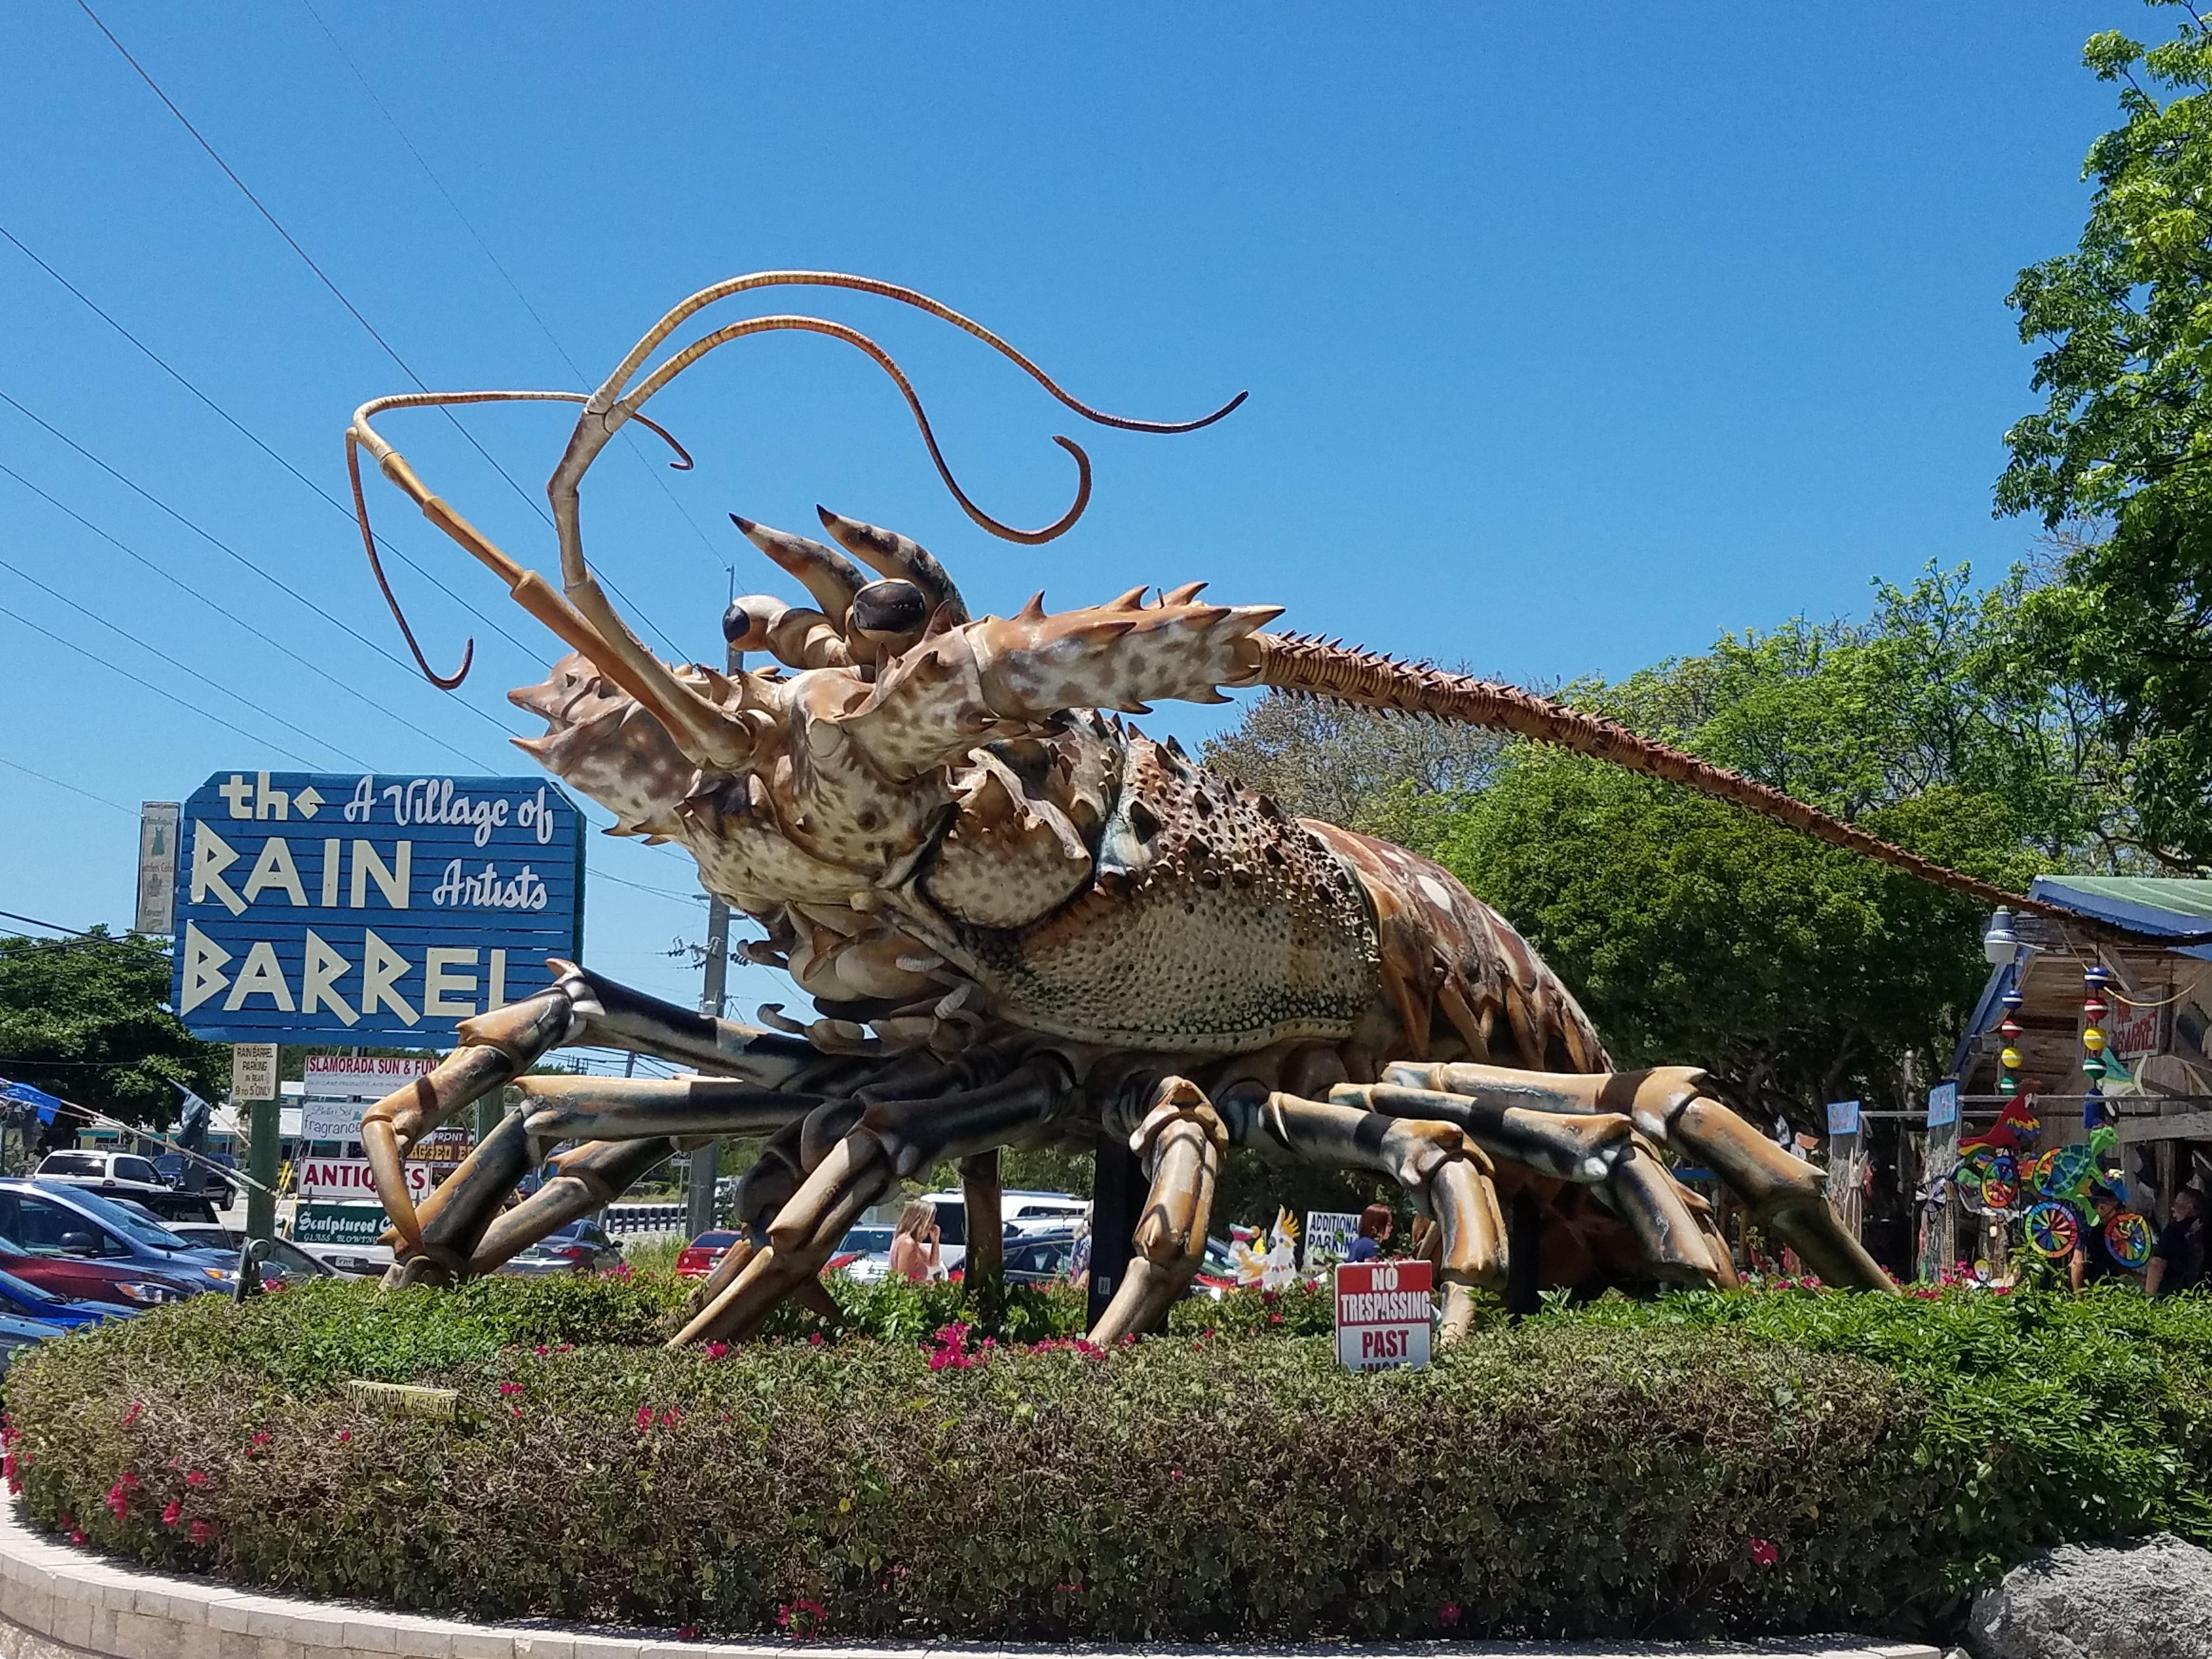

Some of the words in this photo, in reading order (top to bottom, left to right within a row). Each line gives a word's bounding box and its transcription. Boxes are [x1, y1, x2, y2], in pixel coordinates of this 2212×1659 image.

[219, 771, 326, 820] the
[344, 775, 377, 822] A
[383, 778, 509, 847] Village
[518, 786, 554, 844] of
[191, 819, 412, 916] RAIN
[432, 858, 547, 910] Artists
[180, 921, 512, 1027] BARREL
[237, 1047, 252, 1058] RAIN
[252, 1047, 274, 1058] BARREL
[243, 1060, 268, 1071] PARKING
[306, 1057, 374, 1073] ISLAMORADA
[378, 1060, 400, 1074] SUN
[403, 1061, 411, 1075] &
[415, 1060, 437, 1076] FUN
[235, 1085, 240, 1096] 9
[249, 1086, 254, 1096] 5
[255, 1086, 271, 1096] ONLY
[407, 1144, 452, 1161] AGGED
[304, 1164, 425, 1192] ANTIQS
[298, 1211, 376, 1235] Sculptured
[1310, 1214, 1358, 1234] ADDITIONA
[304, 1233, 330, 1242] GLASS
[1308, 1233, 1357, 1253] PARKIN
[1372, 1267, 1399, 1291] NO
[1340, 1290, 1431, 1322] TRESPASSING
[1362, 1330, 1410, 1358] PAST
[437, 1398, 455, 1414] ART
